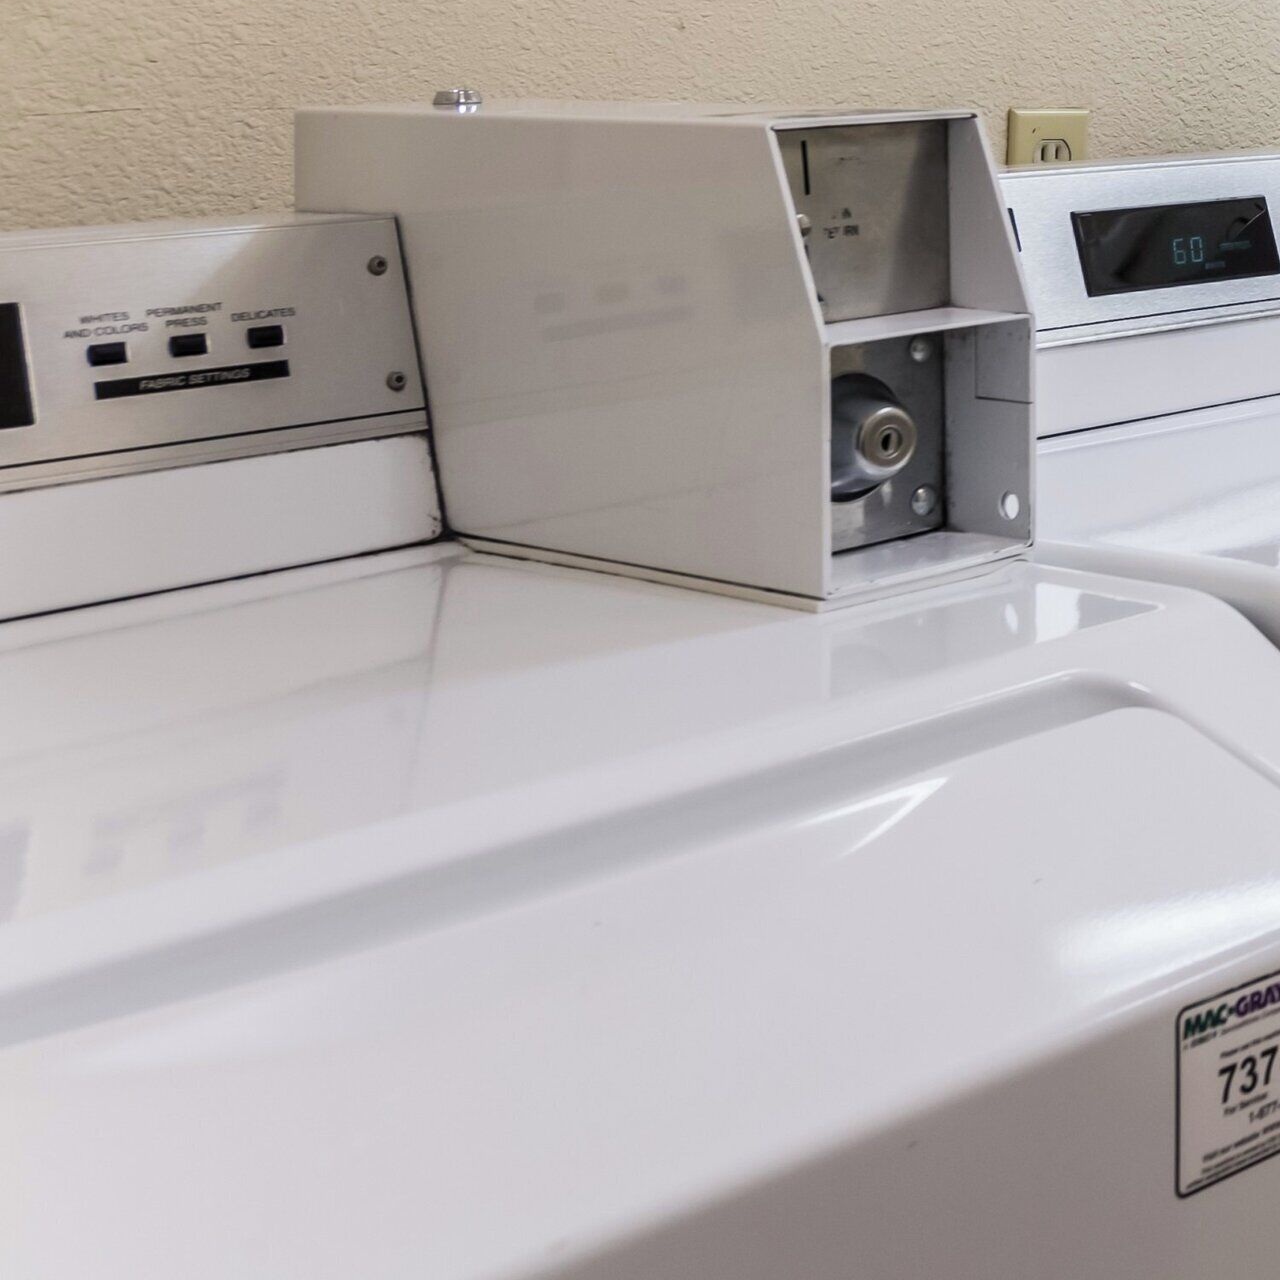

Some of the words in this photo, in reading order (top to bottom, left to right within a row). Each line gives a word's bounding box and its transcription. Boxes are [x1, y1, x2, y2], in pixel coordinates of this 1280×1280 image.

[1172, 236, 1204, 265] 60
[146, 302, 223, 318] PERMANENT
[230, 308, 296, 322] DELICATES
[165, 317, 208, 328] PRESS
[63, 329, 92, 339] AND
[93, 323, 149, 337] COLORS
[139, 376, 186, 391] FABRIC
[188, 369, 251, 387] SETTINGS
